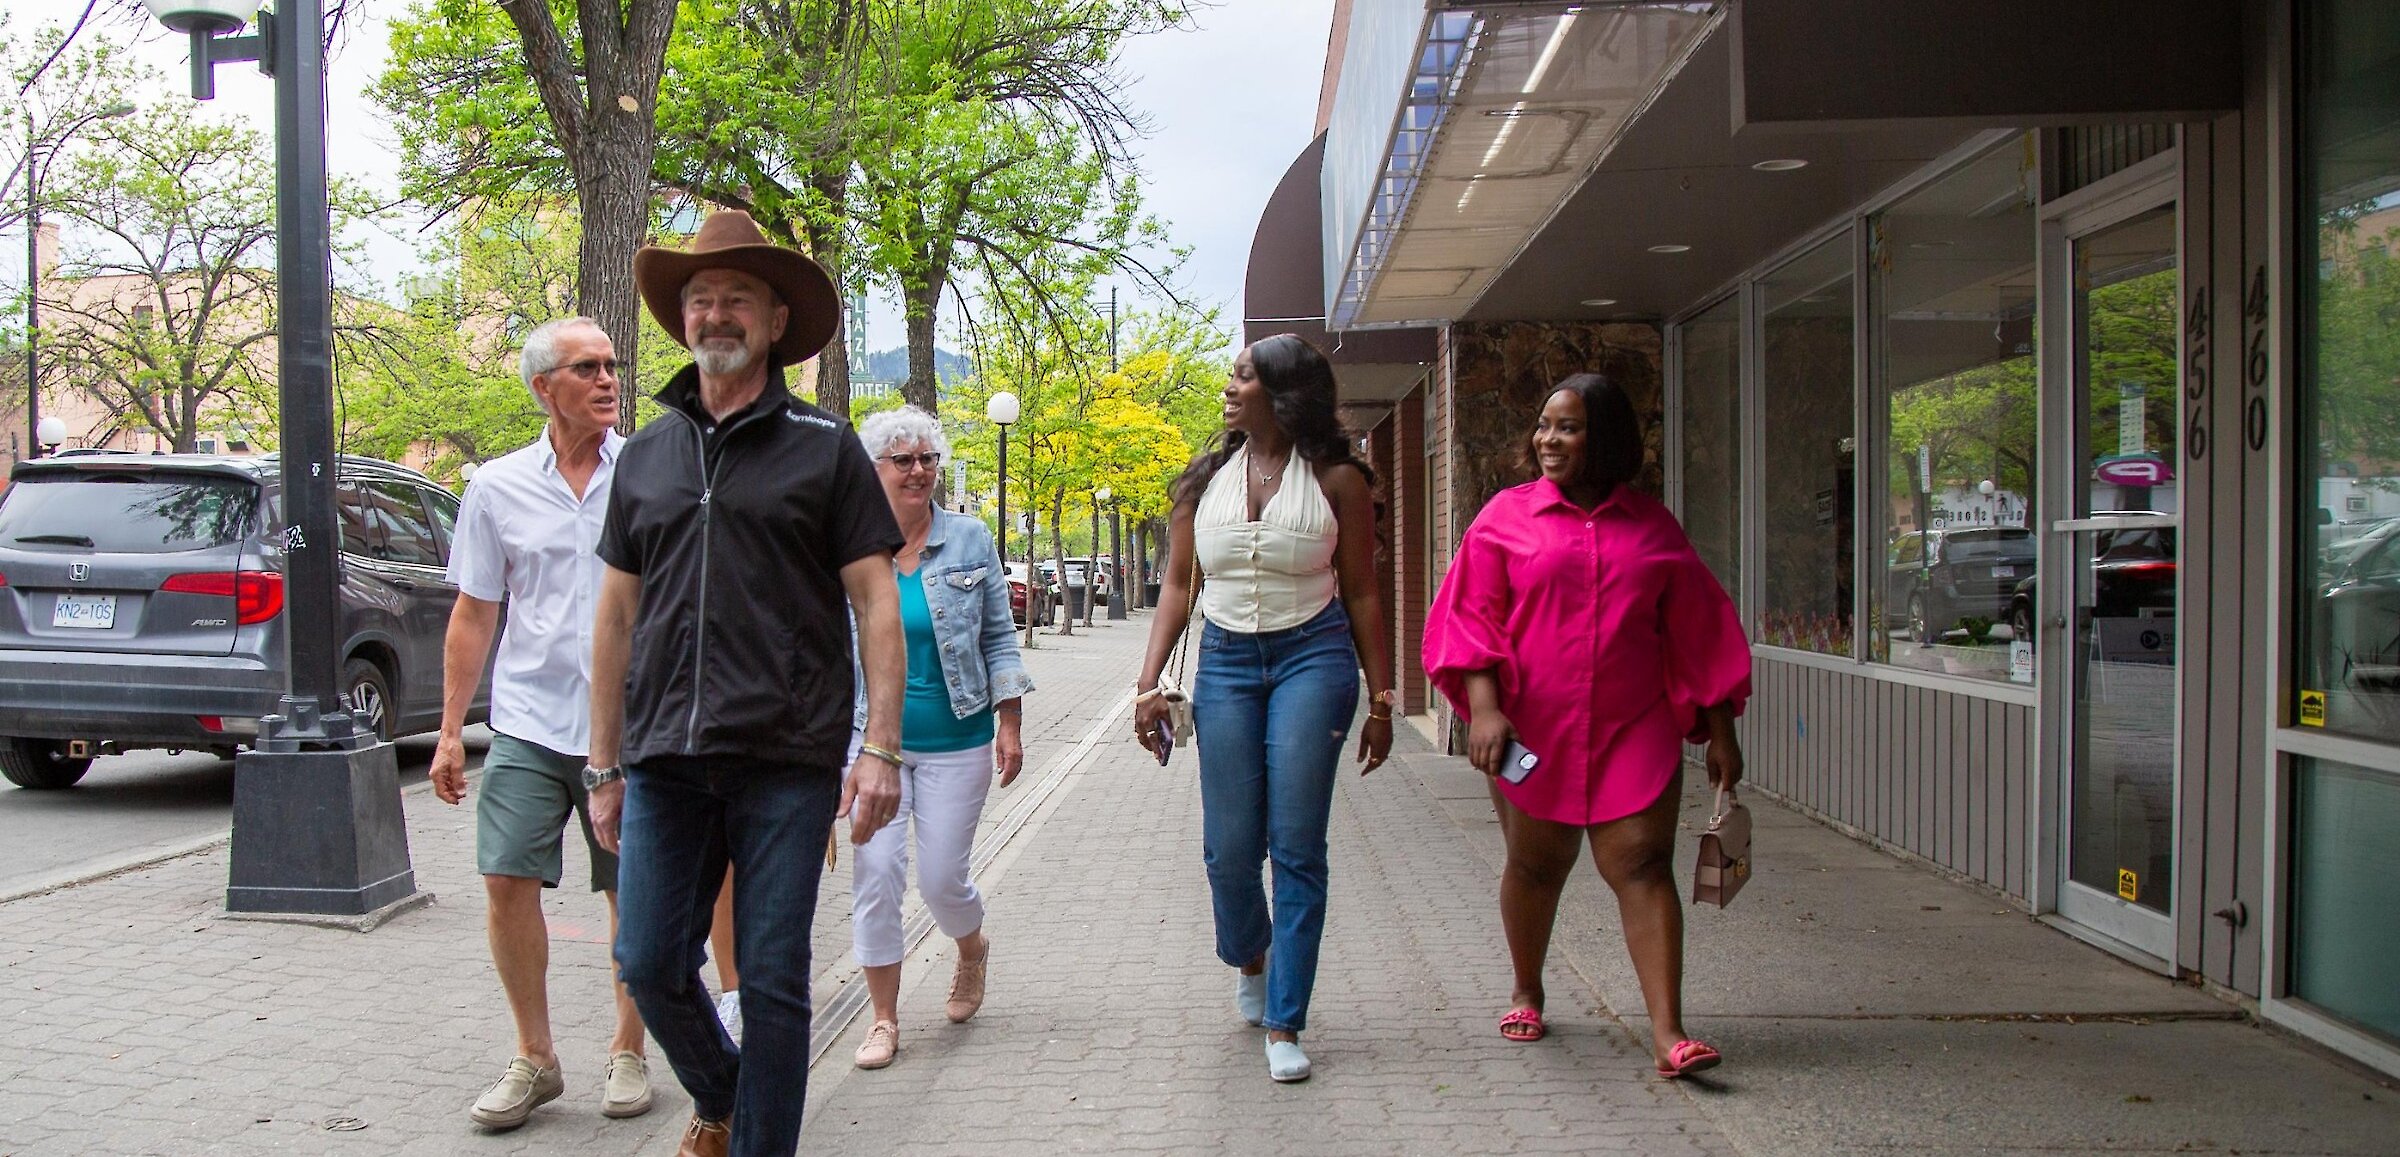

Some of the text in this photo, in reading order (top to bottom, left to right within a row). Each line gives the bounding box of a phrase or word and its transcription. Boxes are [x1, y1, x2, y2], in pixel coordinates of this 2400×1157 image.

[854, 297, 866, 373] LAZA
[2188, 286, 2207, 460] 456
[2247, 265, 2268, 452] 460
[191, 619, 227, 627] AWD
